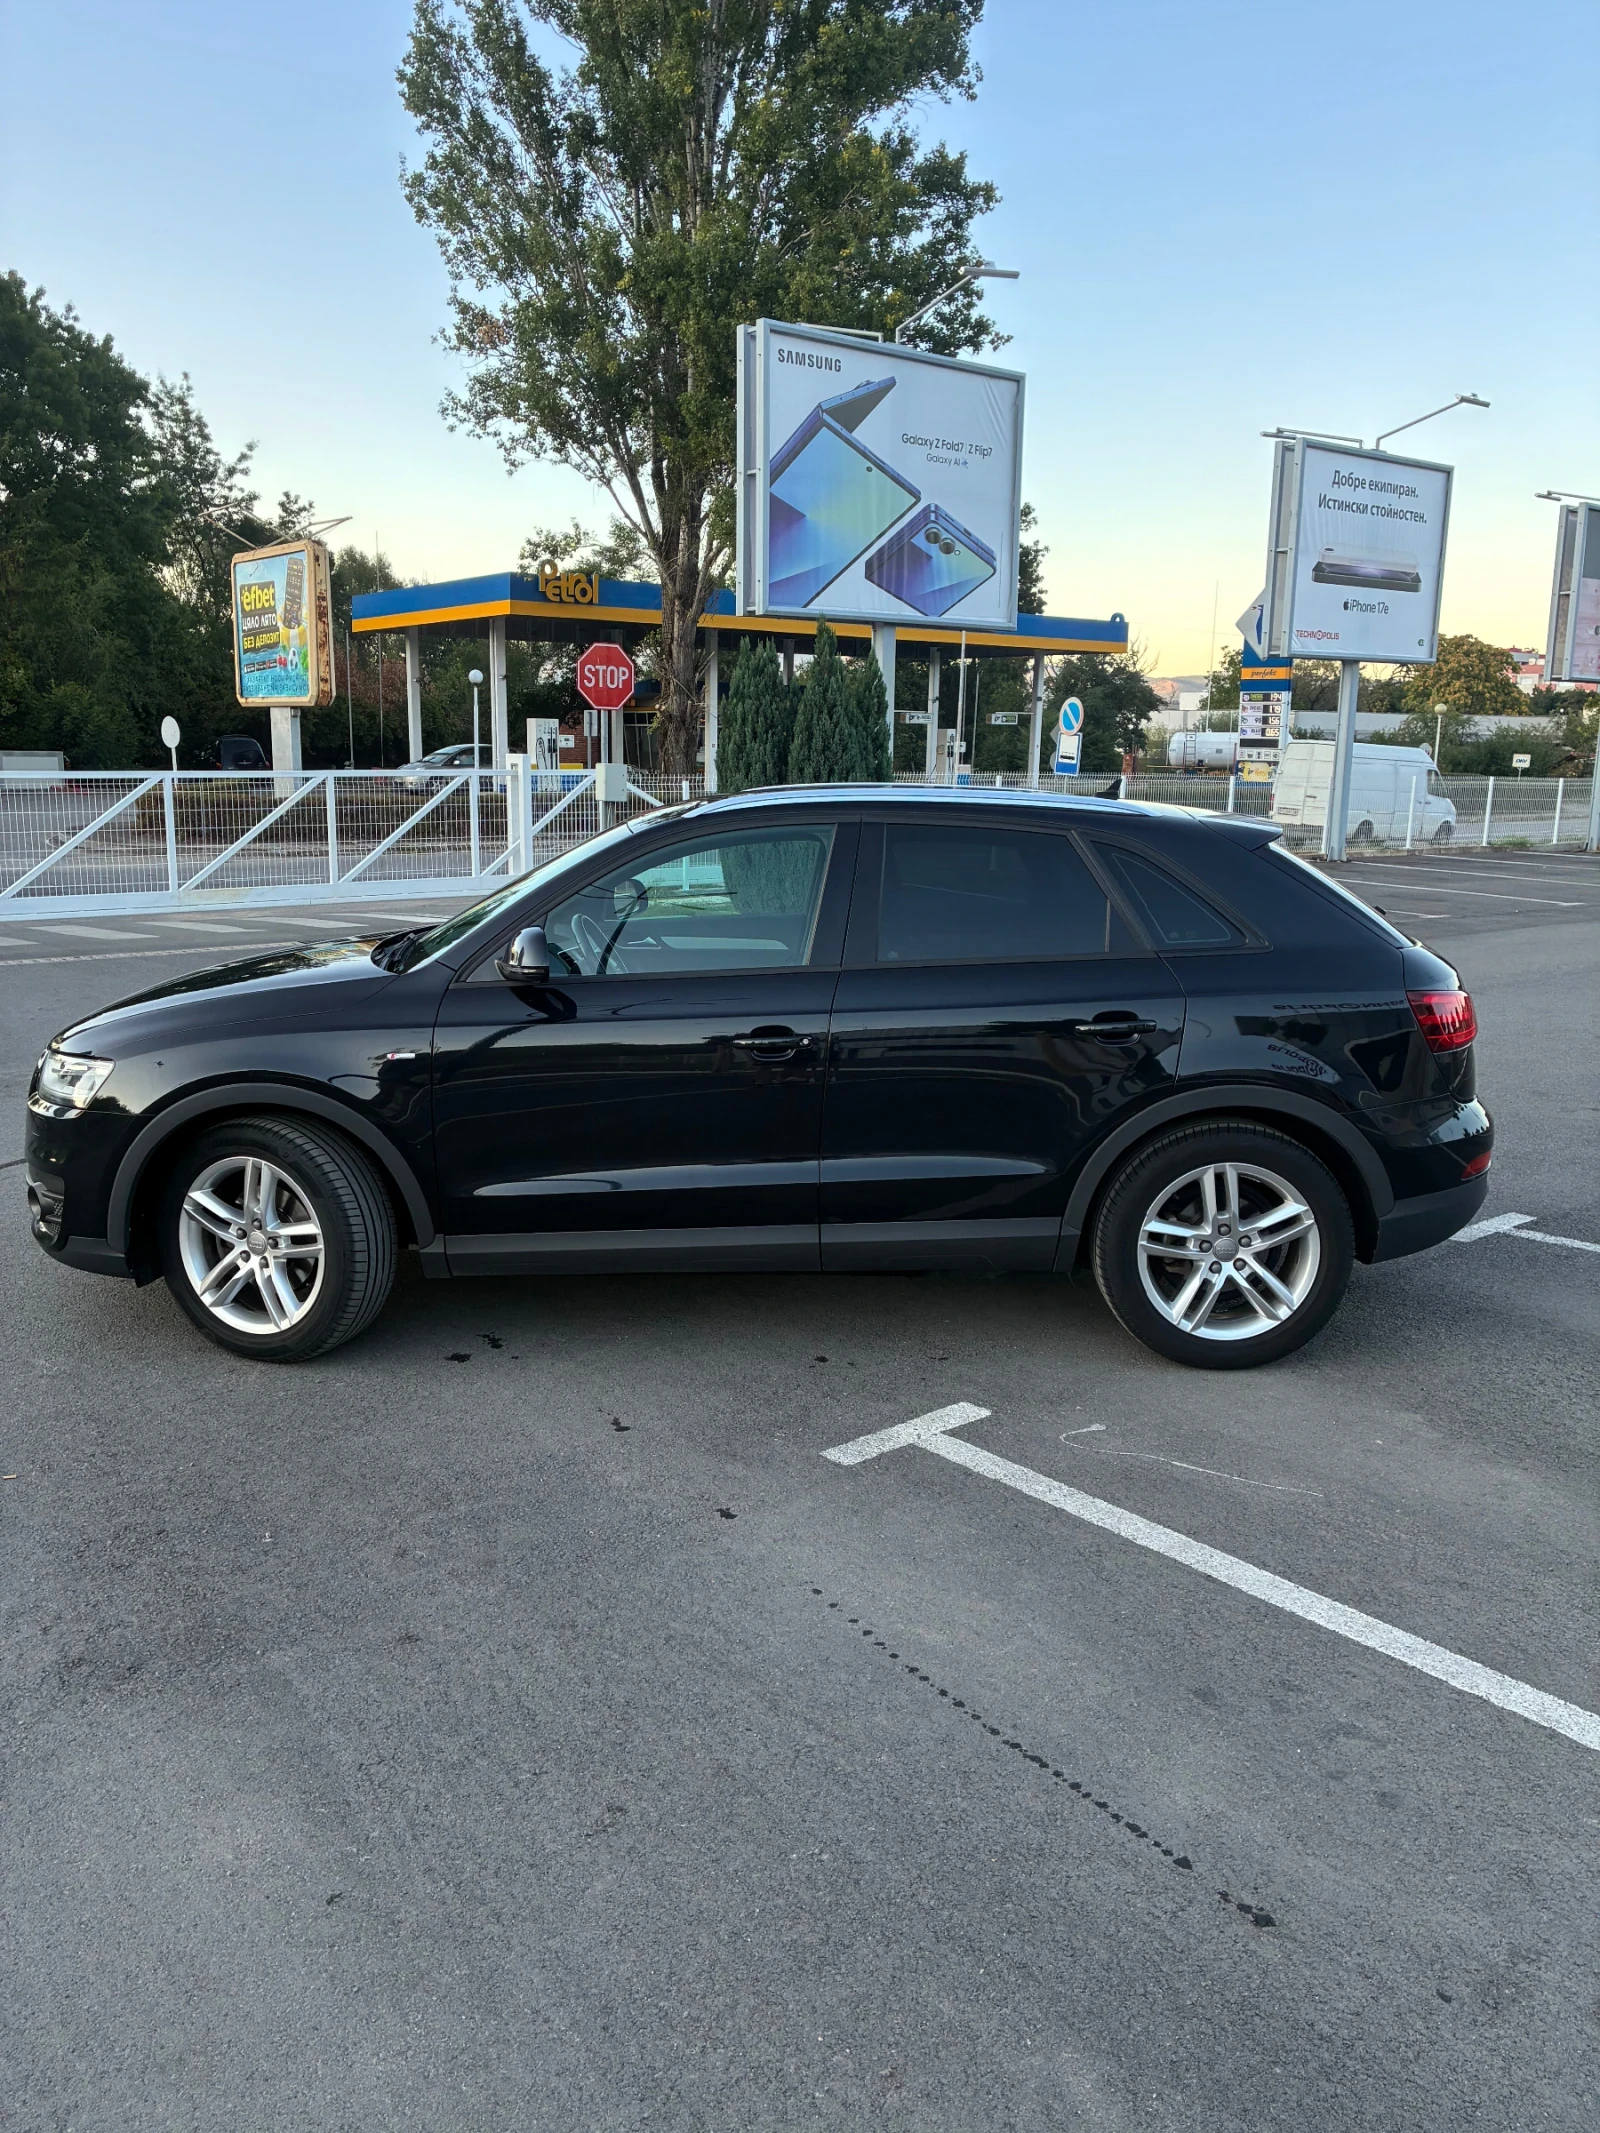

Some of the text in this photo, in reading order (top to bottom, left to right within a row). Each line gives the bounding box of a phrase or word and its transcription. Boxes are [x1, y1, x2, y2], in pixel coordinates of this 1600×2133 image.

[777, 348, 842, 373] SAMSUNG
[901, 432, 993, 460] Galaxy Z Fold7 Z Flip7
[926, 453, 961, 468] Galaxy AI
[1331, 469, 1419, 499] Добре екипиран.
[1318, 492, 1428, 524] Истински стойностен.
[538, 559, 599, 604] Petrol
[242, 585, 275, 612] efbet
[1349, 598, 1389, 615] iPhone 17e
[242, 613, 277, 632] ЦЯЛО ЛЯТО
[1295, 629, 1340, 641] TECHNOPOLIS
[243, 631, 280, 650] БЕЗ ДЕПОЗИТ
[583, 664, 629, 689] STOP
